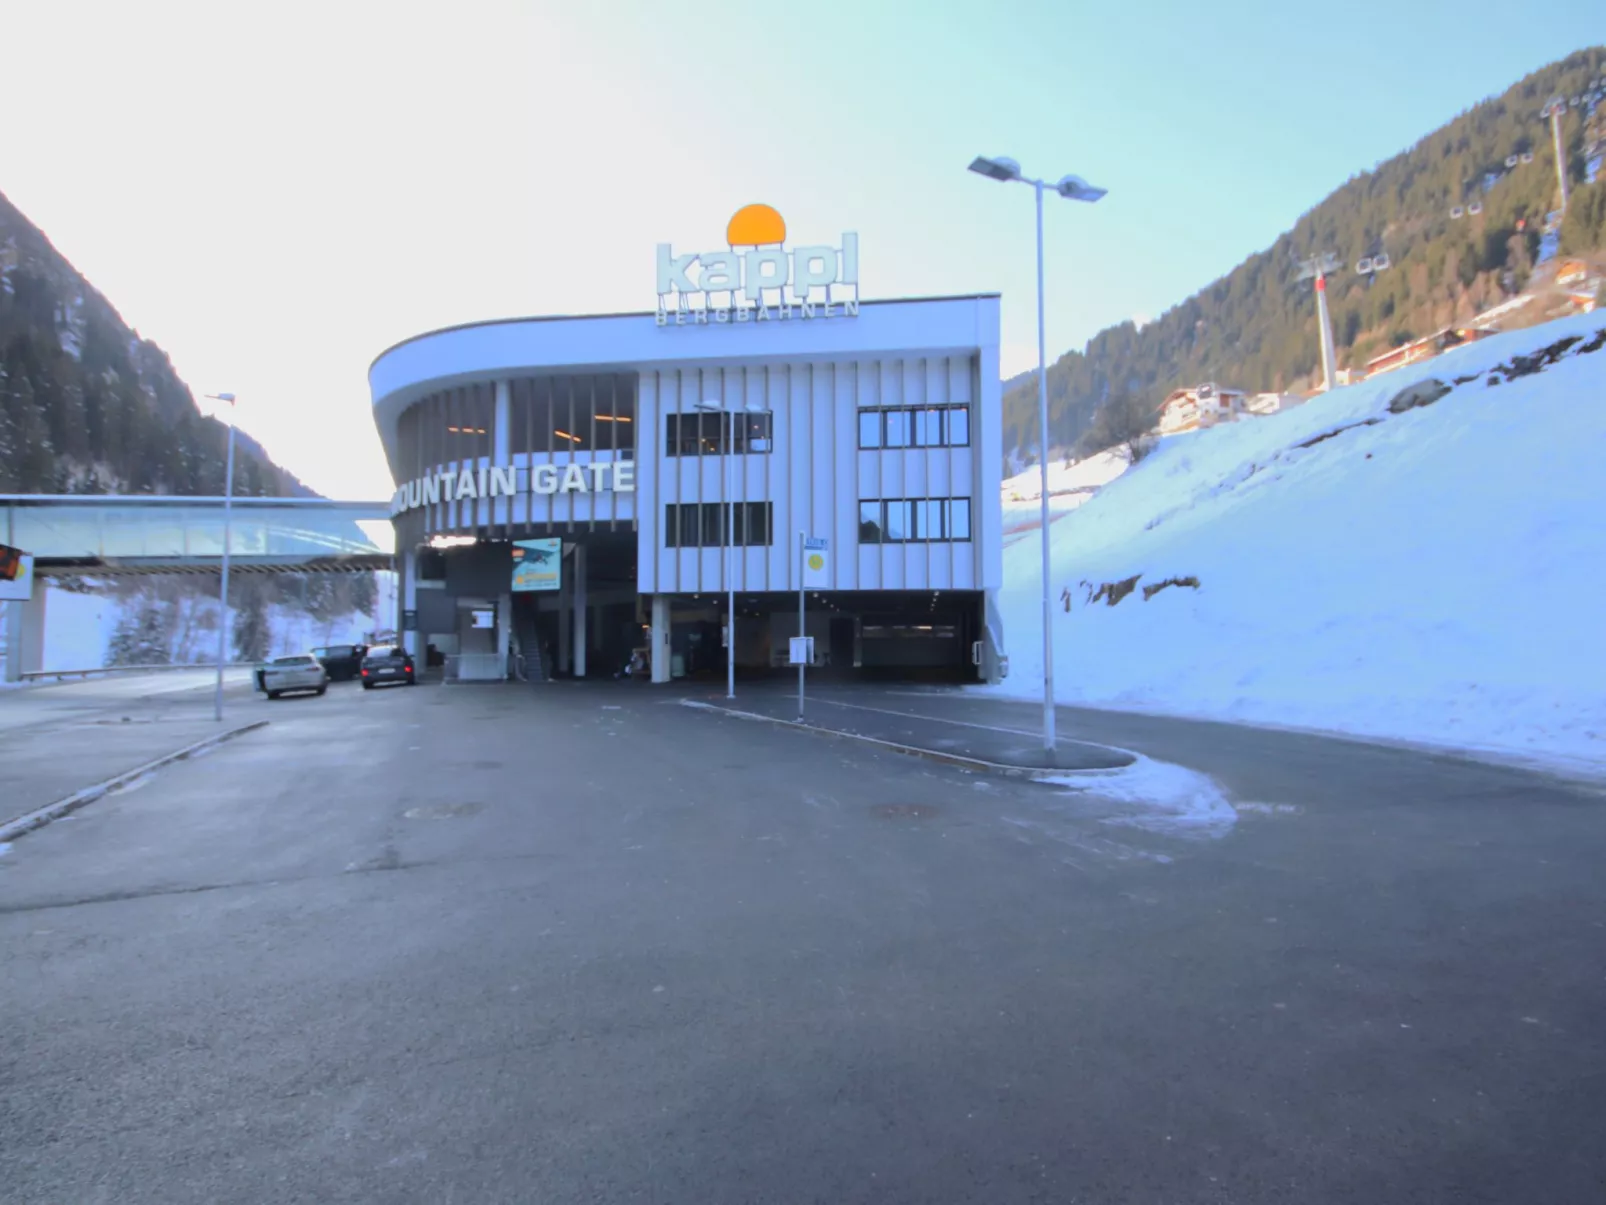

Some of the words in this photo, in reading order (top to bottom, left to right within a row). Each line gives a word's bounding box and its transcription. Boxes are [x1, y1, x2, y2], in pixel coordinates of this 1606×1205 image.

[656, 232, 858, 300] kappl
[655, 301, 859, 326] BERGBAHNEN
[532, 461, 635, 495] GATE
